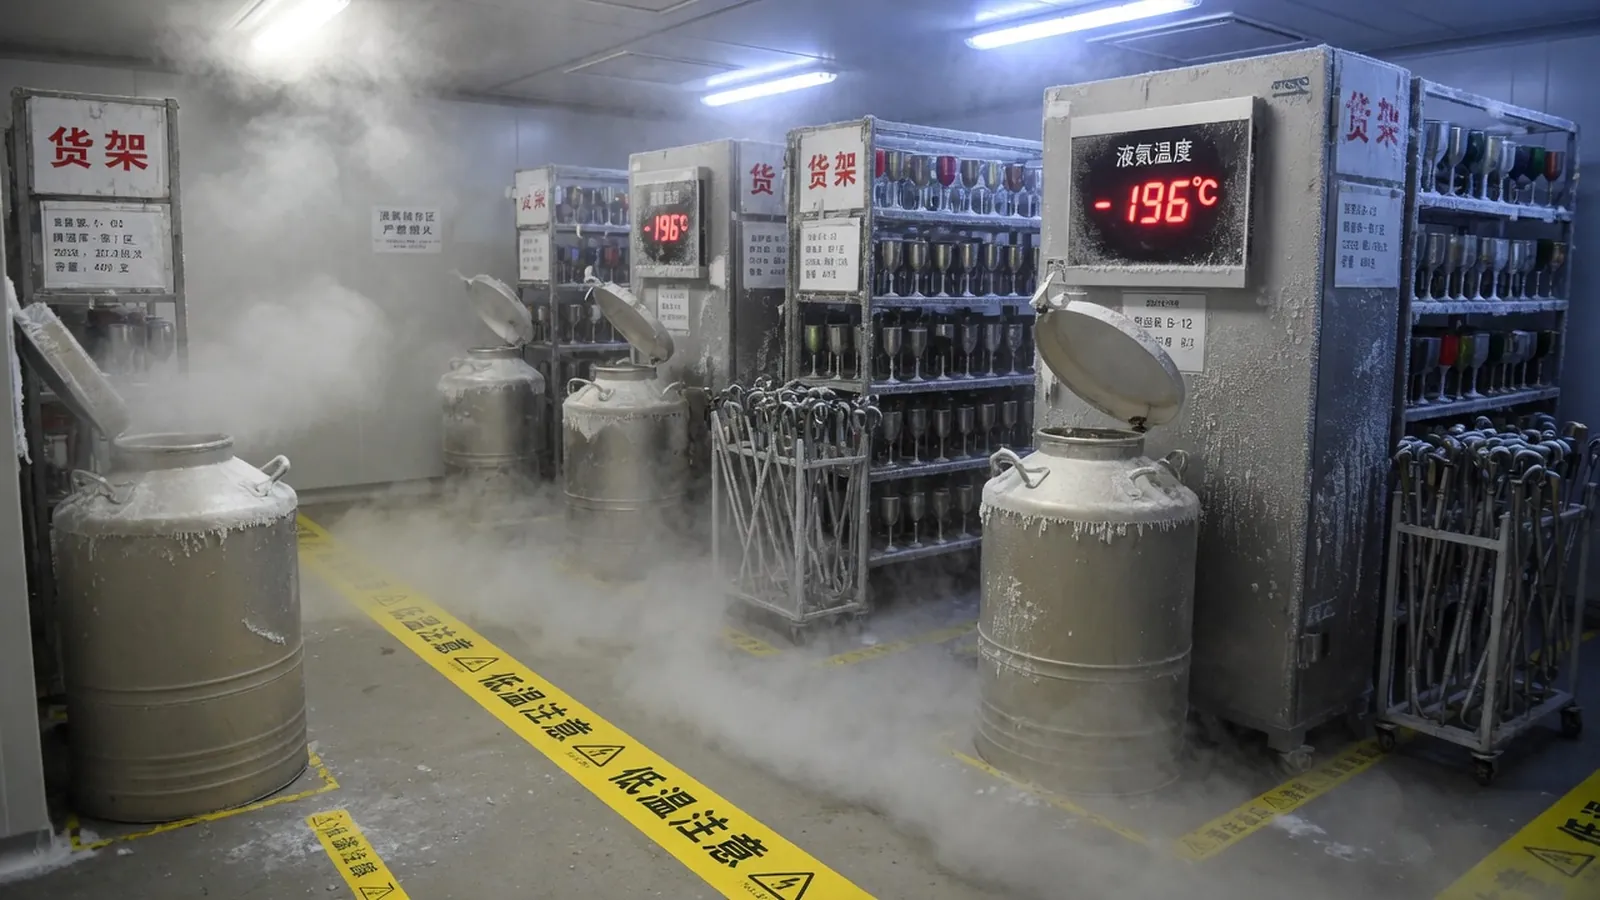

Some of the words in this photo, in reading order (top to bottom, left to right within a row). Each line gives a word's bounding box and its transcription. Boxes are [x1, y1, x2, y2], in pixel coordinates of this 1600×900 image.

[48, 126, 148, 171] 货架
[808, 151, 856, 190] 货架
[750, 163, 776, 196] 货
[478, 672, 593, 742] 低温注意
[608, 766, 769, 868] 低温注意
